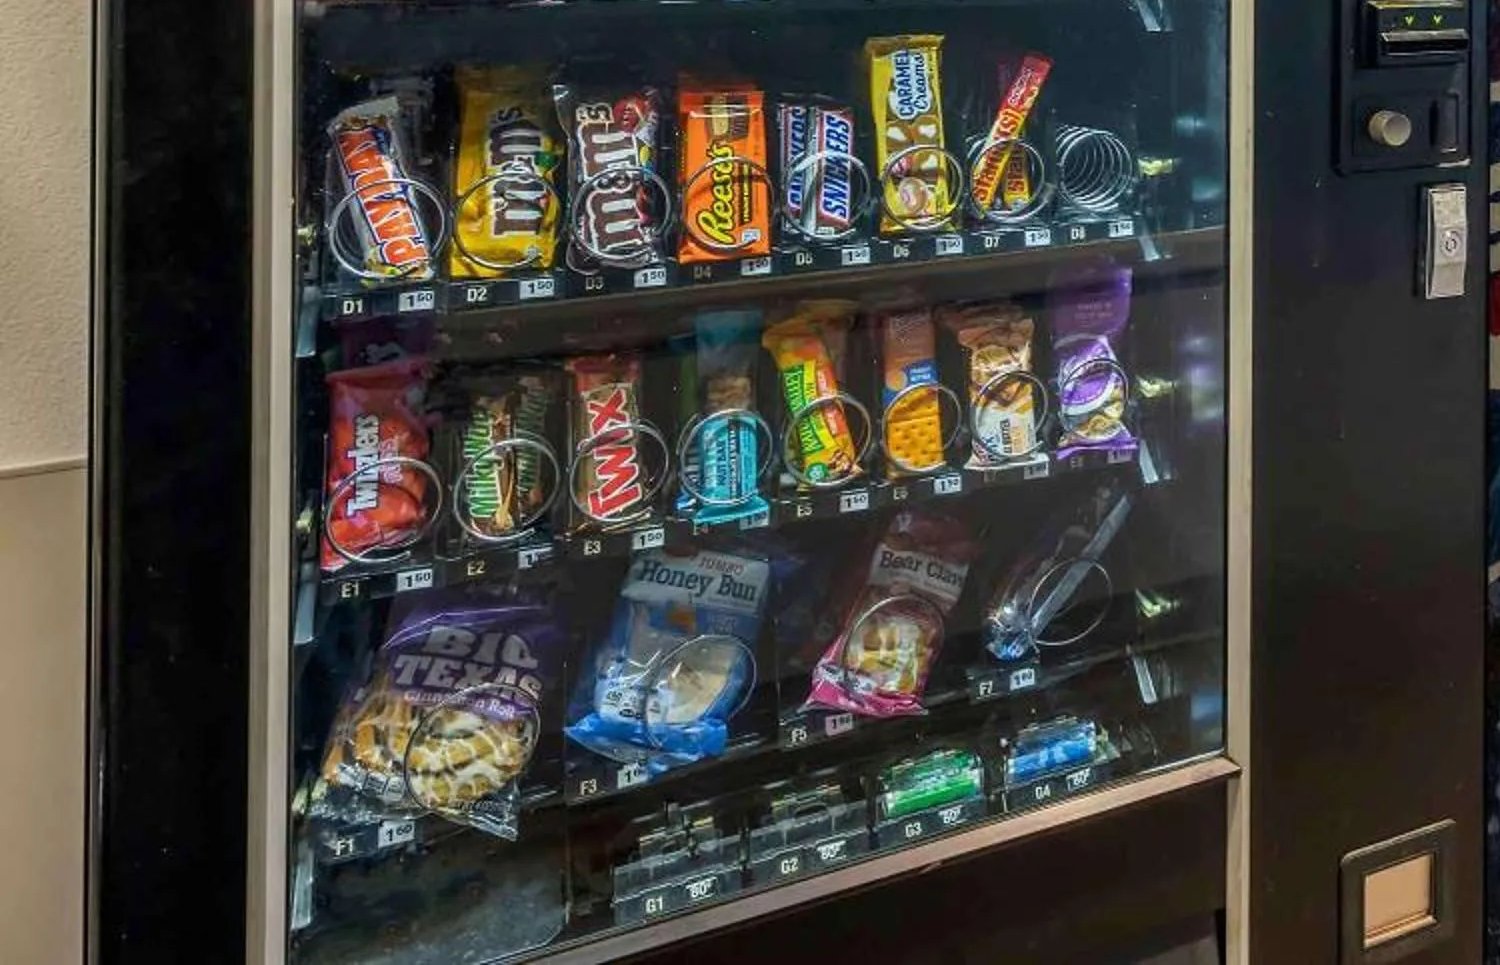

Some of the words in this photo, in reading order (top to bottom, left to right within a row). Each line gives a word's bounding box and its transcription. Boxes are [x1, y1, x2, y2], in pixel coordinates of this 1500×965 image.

[897, 50, 915, 117] CARAMEL
[821, 114, 851, 219] SNICKERS
[337, 126, 430, 268] PAYDAY
[698, 137, 737, 245] Reese's
[586, 276, 604, 290] D3
[467, 287, 487, 302] D2
[343, 300, 363, 314] D1
[587, 388, 644, 519] TWIX
[346, 414, 380, 517] Twizzlers
[584, 540, 601, 556] E3
[467, 559, 485, 576] E2
[879, 550, 923, 573] Bear
[925, 563, 963, 585] Claw
[639, 559, 715, 598] Honey
[716, 574, 757, 602] Bun
[341, 581, 360, 598] E1
[422, 625, 539, 670] BIG
[393, 654, 544, 701] TEXAS
[579, 779, 597, 795] F3
[905, 823, 922, 837] G3
[336, 839, 354, 856] F1
[781, 858, 799, 874] G2
[645, 897, 664, 913] G1
